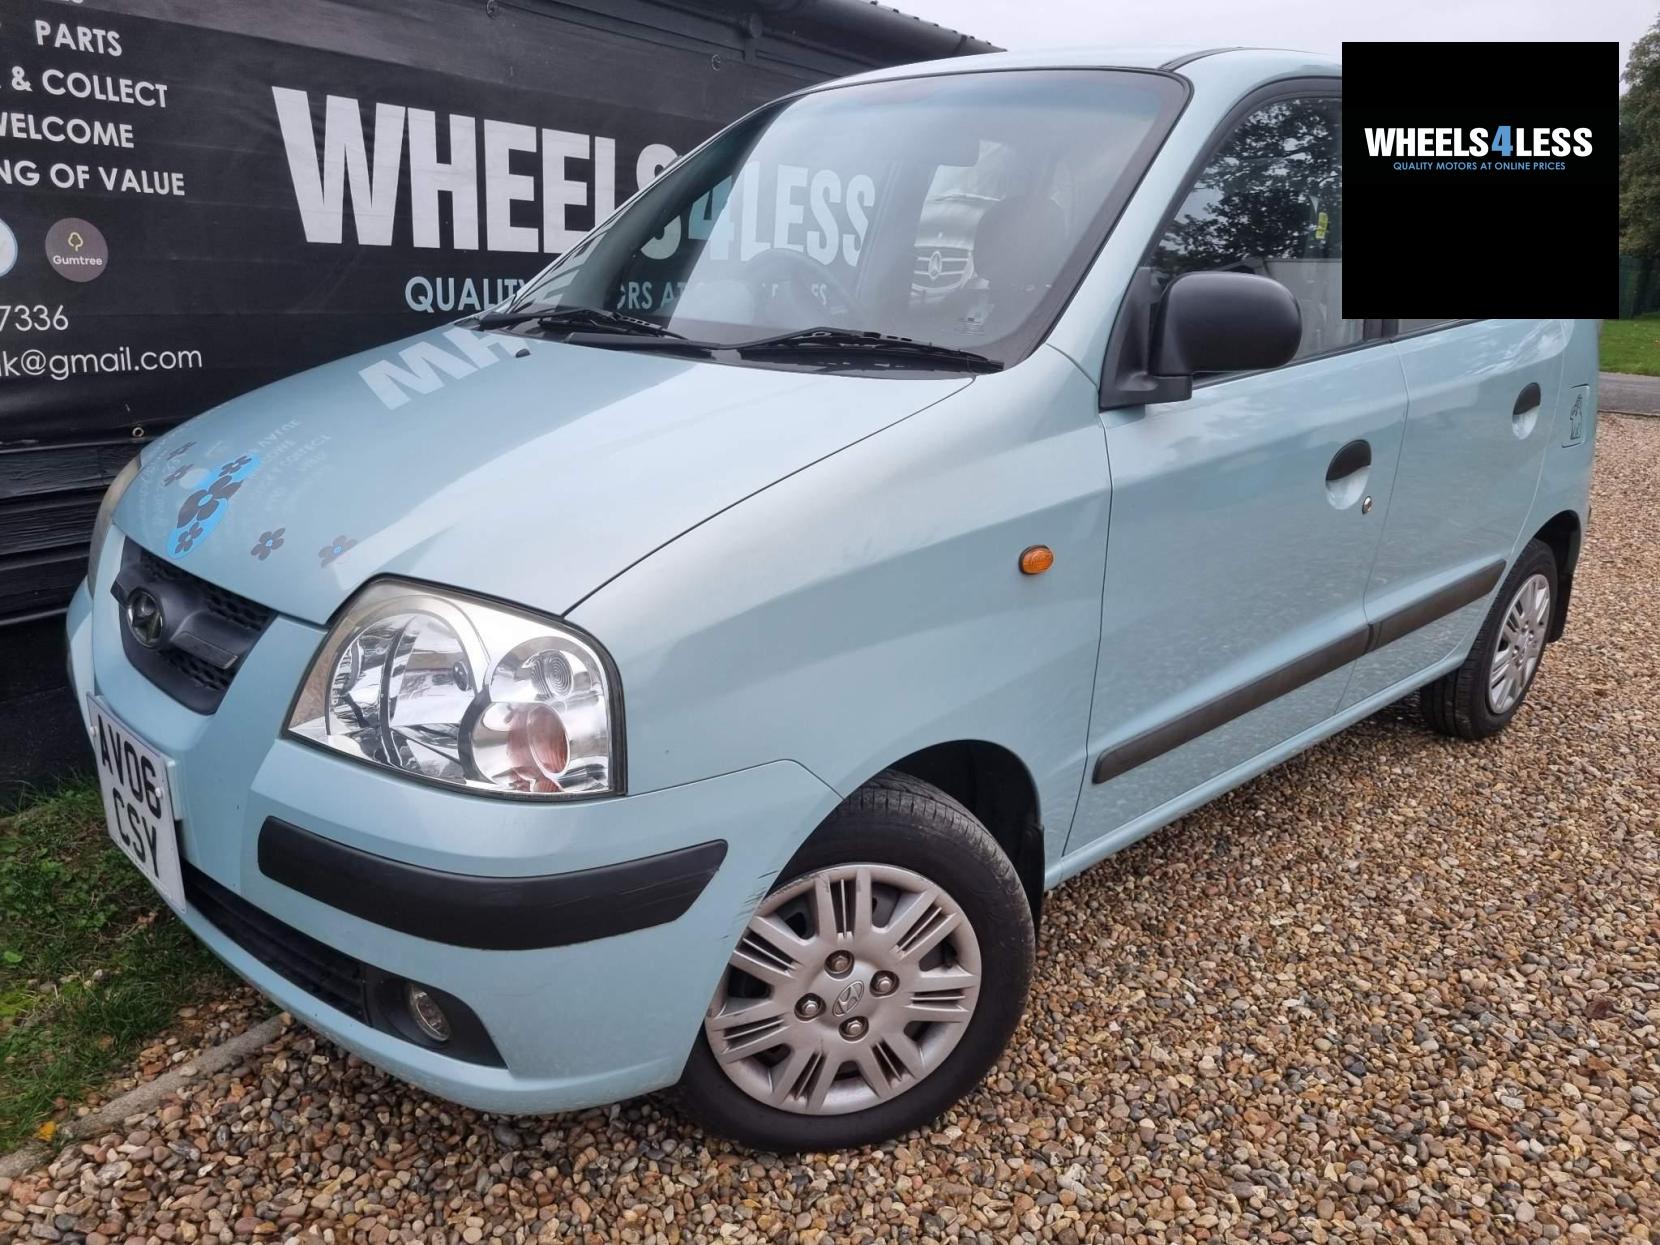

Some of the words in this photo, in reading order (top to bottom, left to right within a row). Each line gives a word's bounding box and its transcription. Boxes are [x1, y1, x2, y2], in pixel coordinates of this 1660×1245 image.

[35, 19, 123, 57] PARTS
[11, 66, 33, 92] &
[42, 69, 168, 108] COLLECT
[50, 163, 90, 189] OF
[98, 166, 186, 196] VALUE
[52, 254, 103, 267] Gumtree
[0, 304, 69, 332] 7336
[0, 346, 203, 381] k@gmail.com
[97, 713, 162, 820] AV06
[112, 786, 160, 880] CSY
